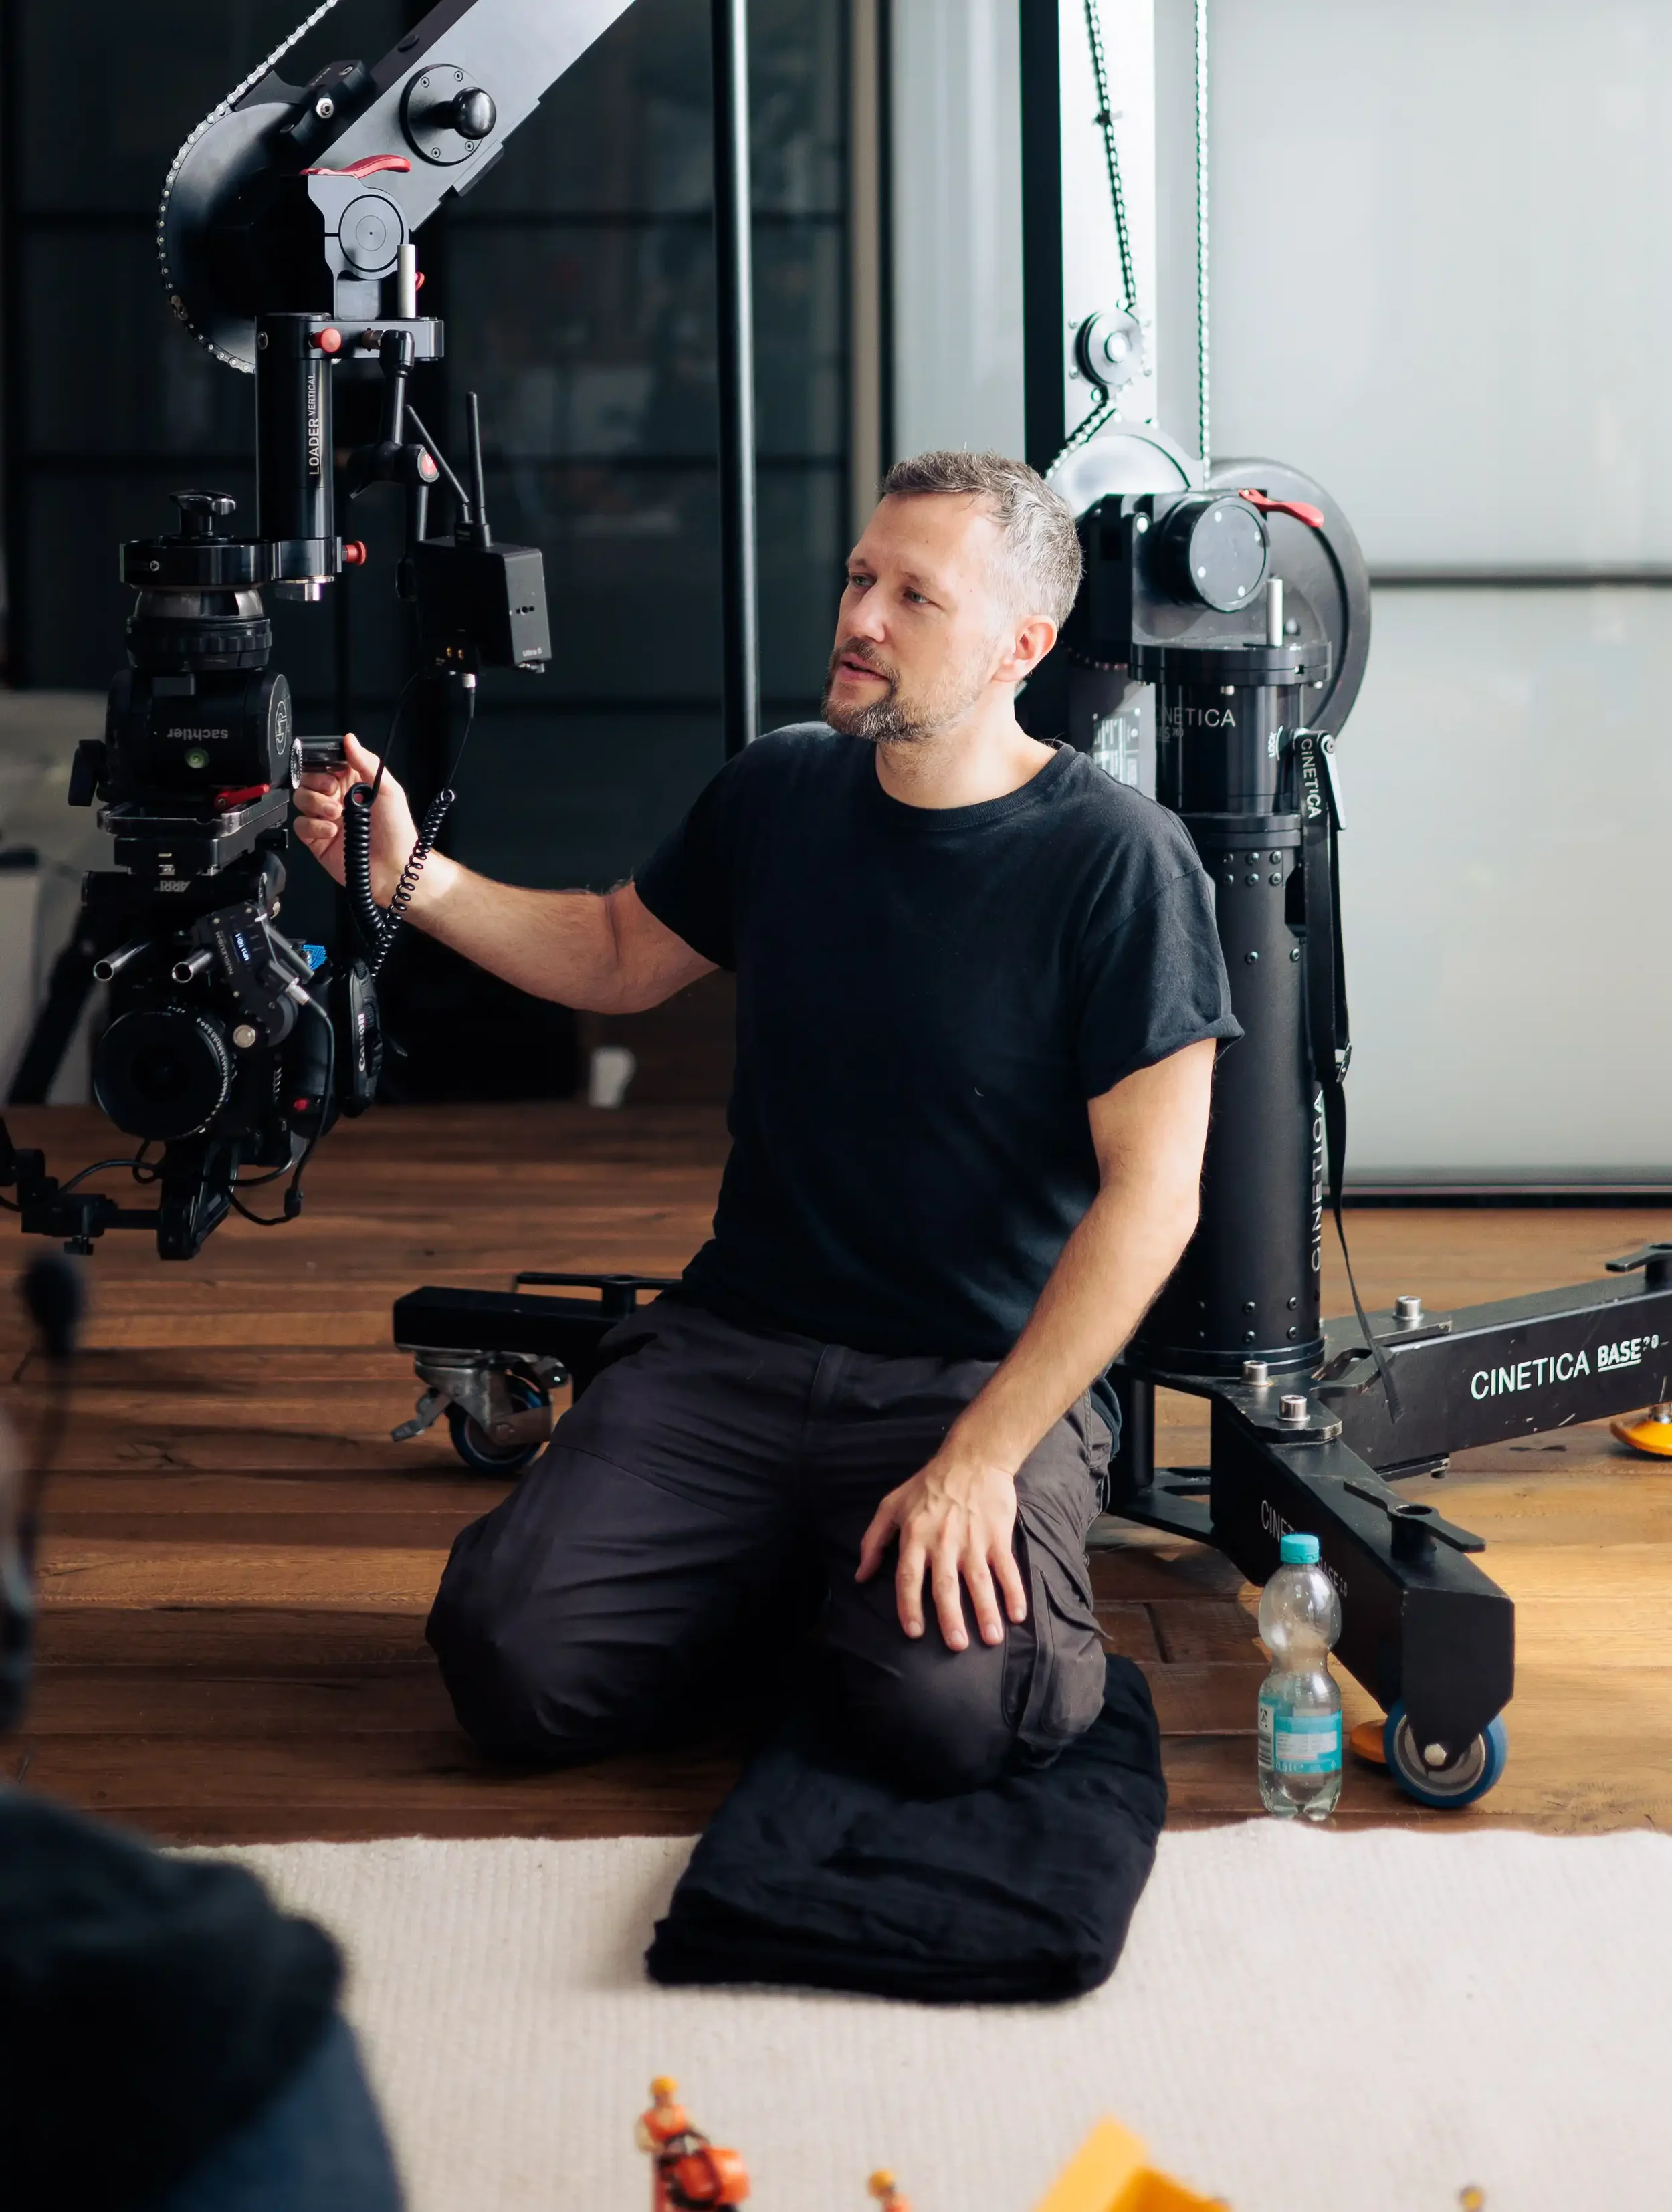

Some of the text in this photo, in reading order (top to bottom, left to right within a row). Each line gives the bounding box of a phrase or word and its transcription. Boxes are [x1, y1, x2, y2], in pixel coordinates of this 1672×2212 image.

[308, 372, 320, 475] LOADER VERTICAL
[167, 728, 228, 740] sachtler
[1301, 738, 1322, 818] CINETICA
[160, 880, 191, 892] ARRI
[1471, 1350, 1590, 1400] CINETICA
[1597, 1337, 1642, 1369] BASE
